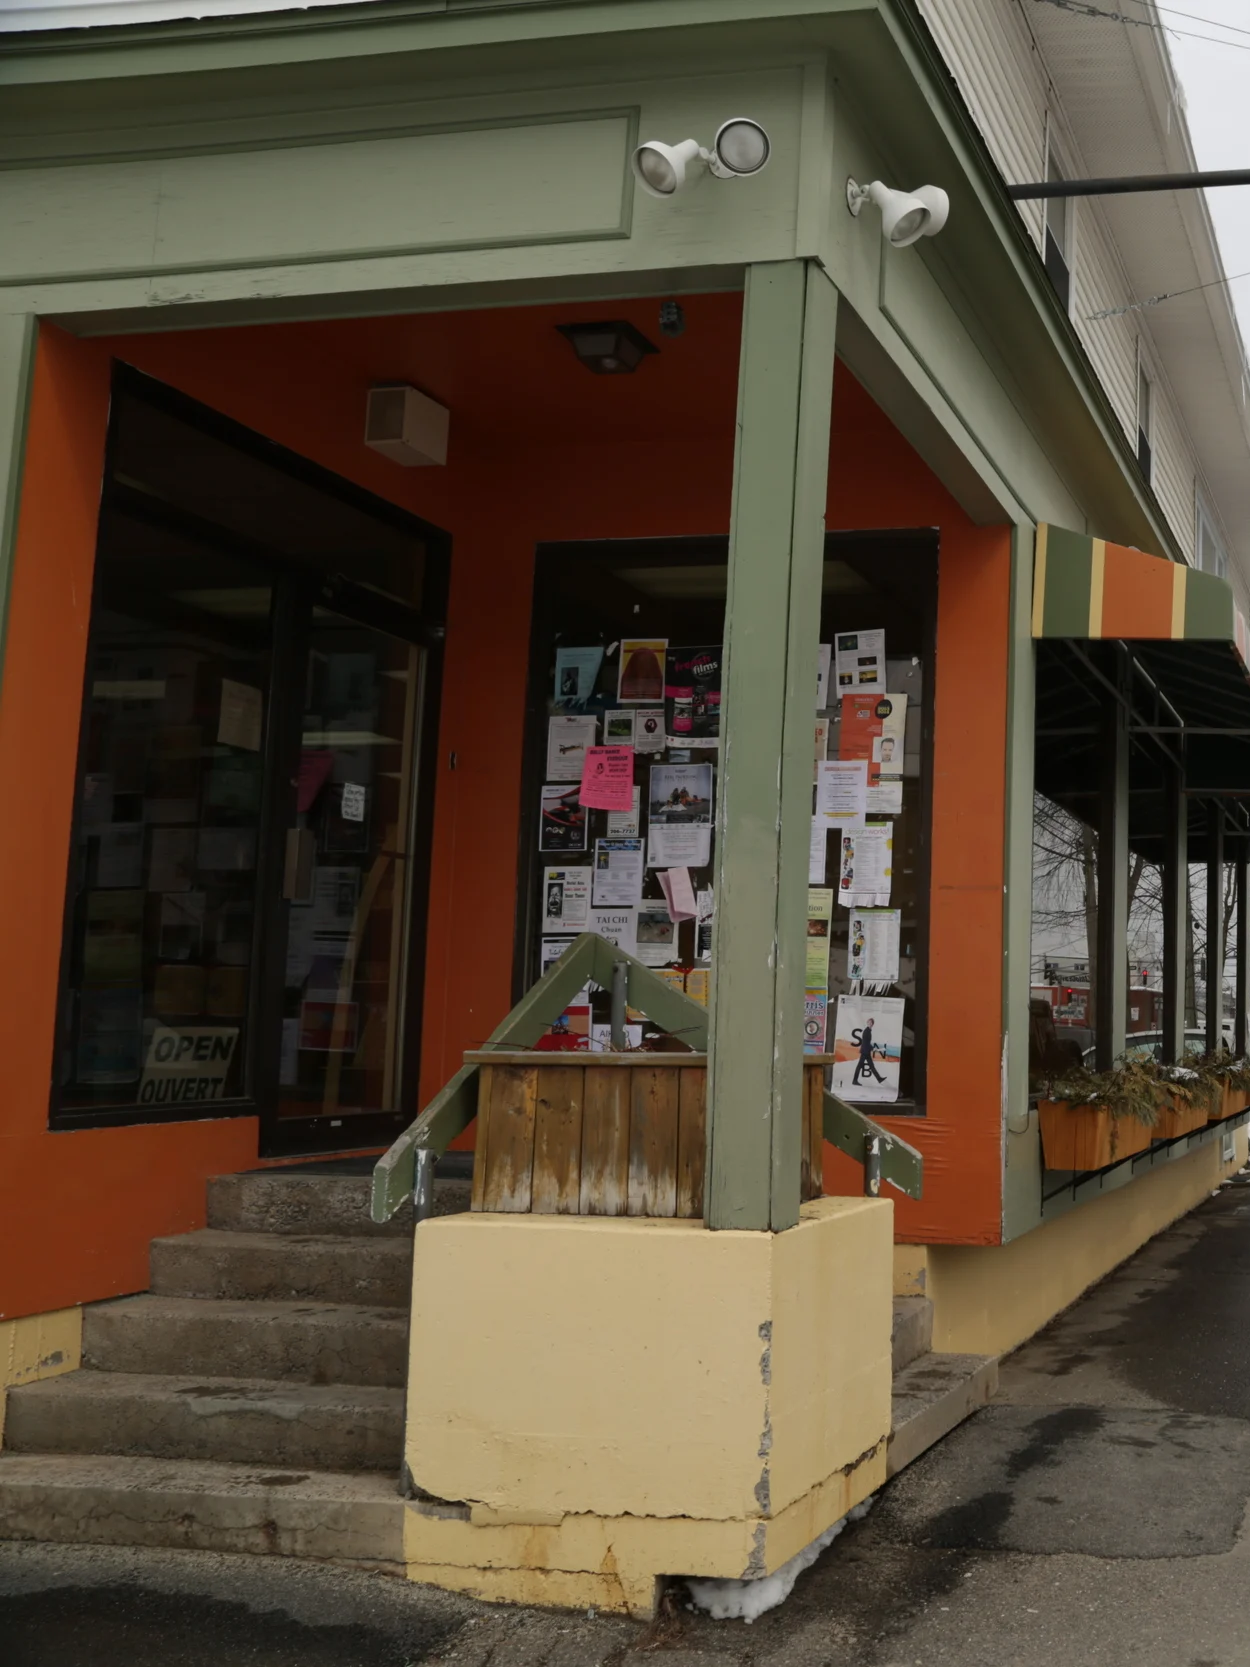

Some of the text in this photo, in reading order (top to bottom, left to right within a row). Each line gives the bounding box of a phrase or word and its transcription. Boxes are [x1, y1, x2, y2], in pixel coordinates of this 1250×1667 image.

[693, 661, 718, 675] films
[596, 916, 628, 924] TAI CHI
[154, 1036, 234, 1062] OPEN
[141, 1077, 224, 1103] OUVERT
